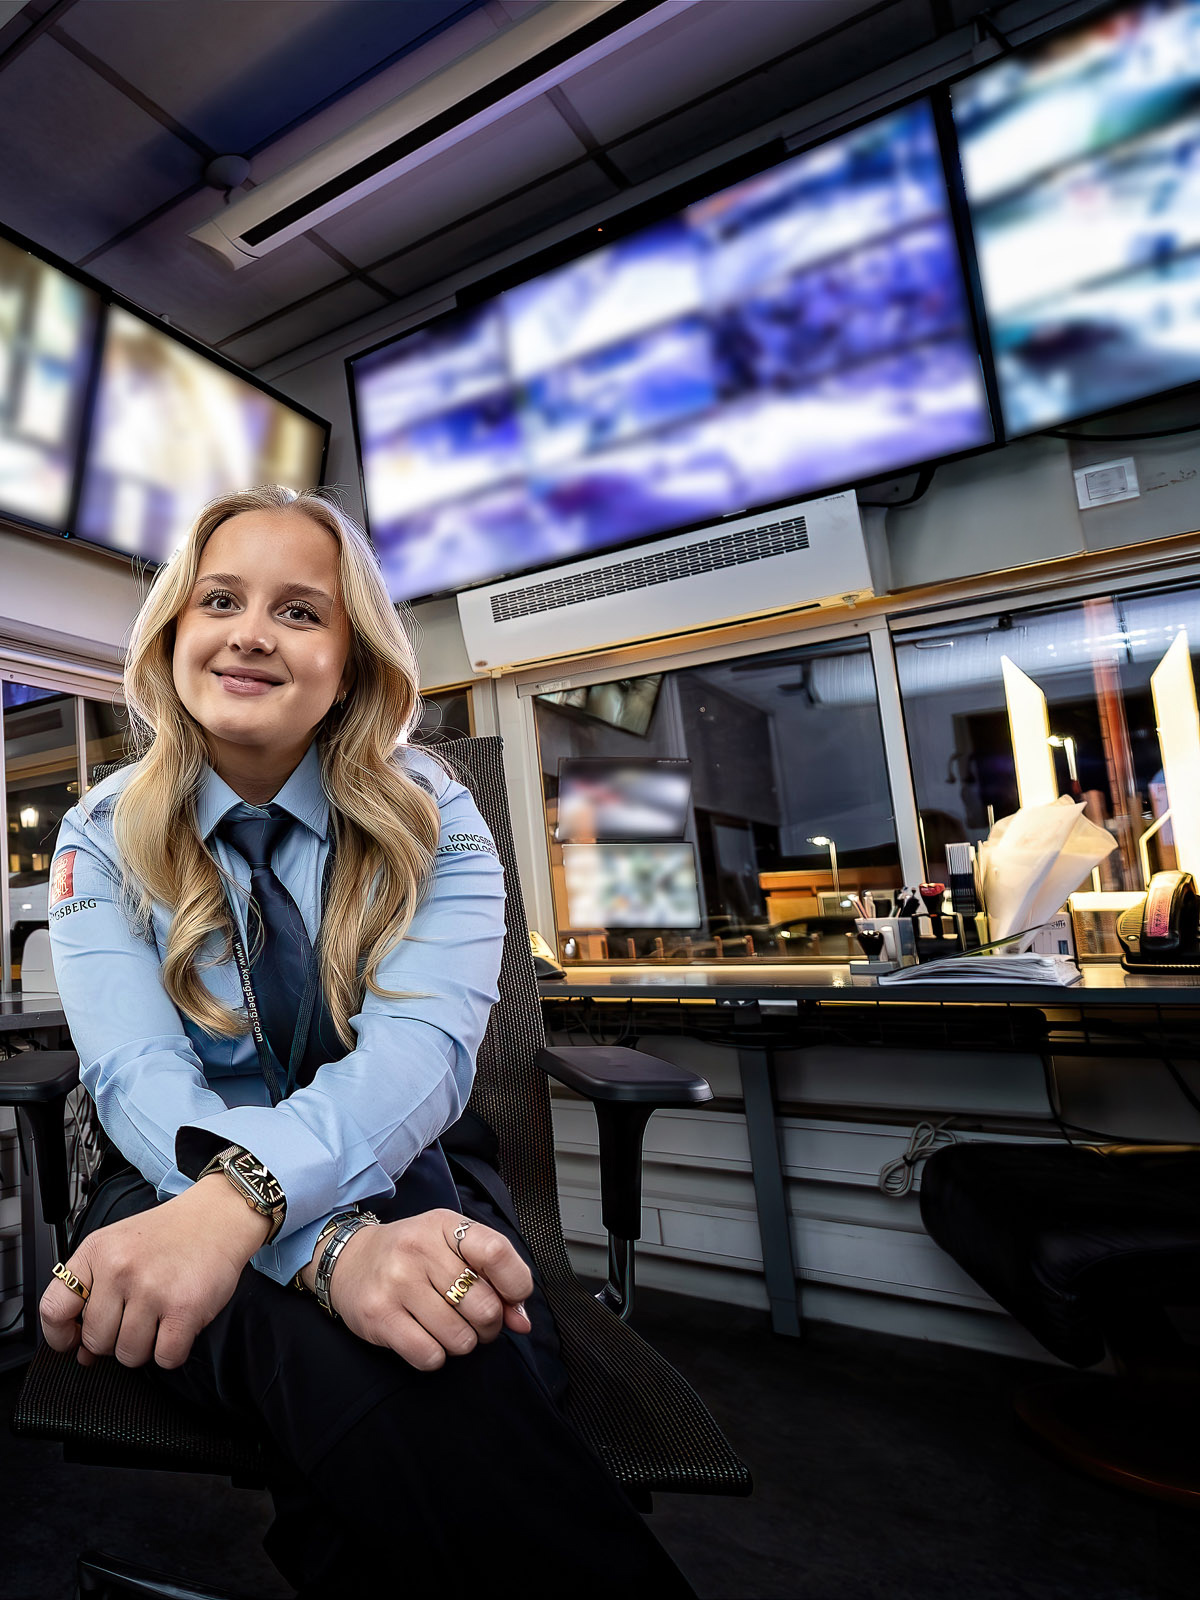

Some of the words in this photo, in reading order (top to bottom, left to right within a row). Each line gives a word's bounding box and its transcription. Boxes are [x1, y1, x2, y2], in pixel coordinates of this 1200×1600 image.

[235, 942, 264, 1043] www.kongsberg.com
[52, 1262, 79, 1289] DAD
[445, 1267, 479, 1304] MOM
